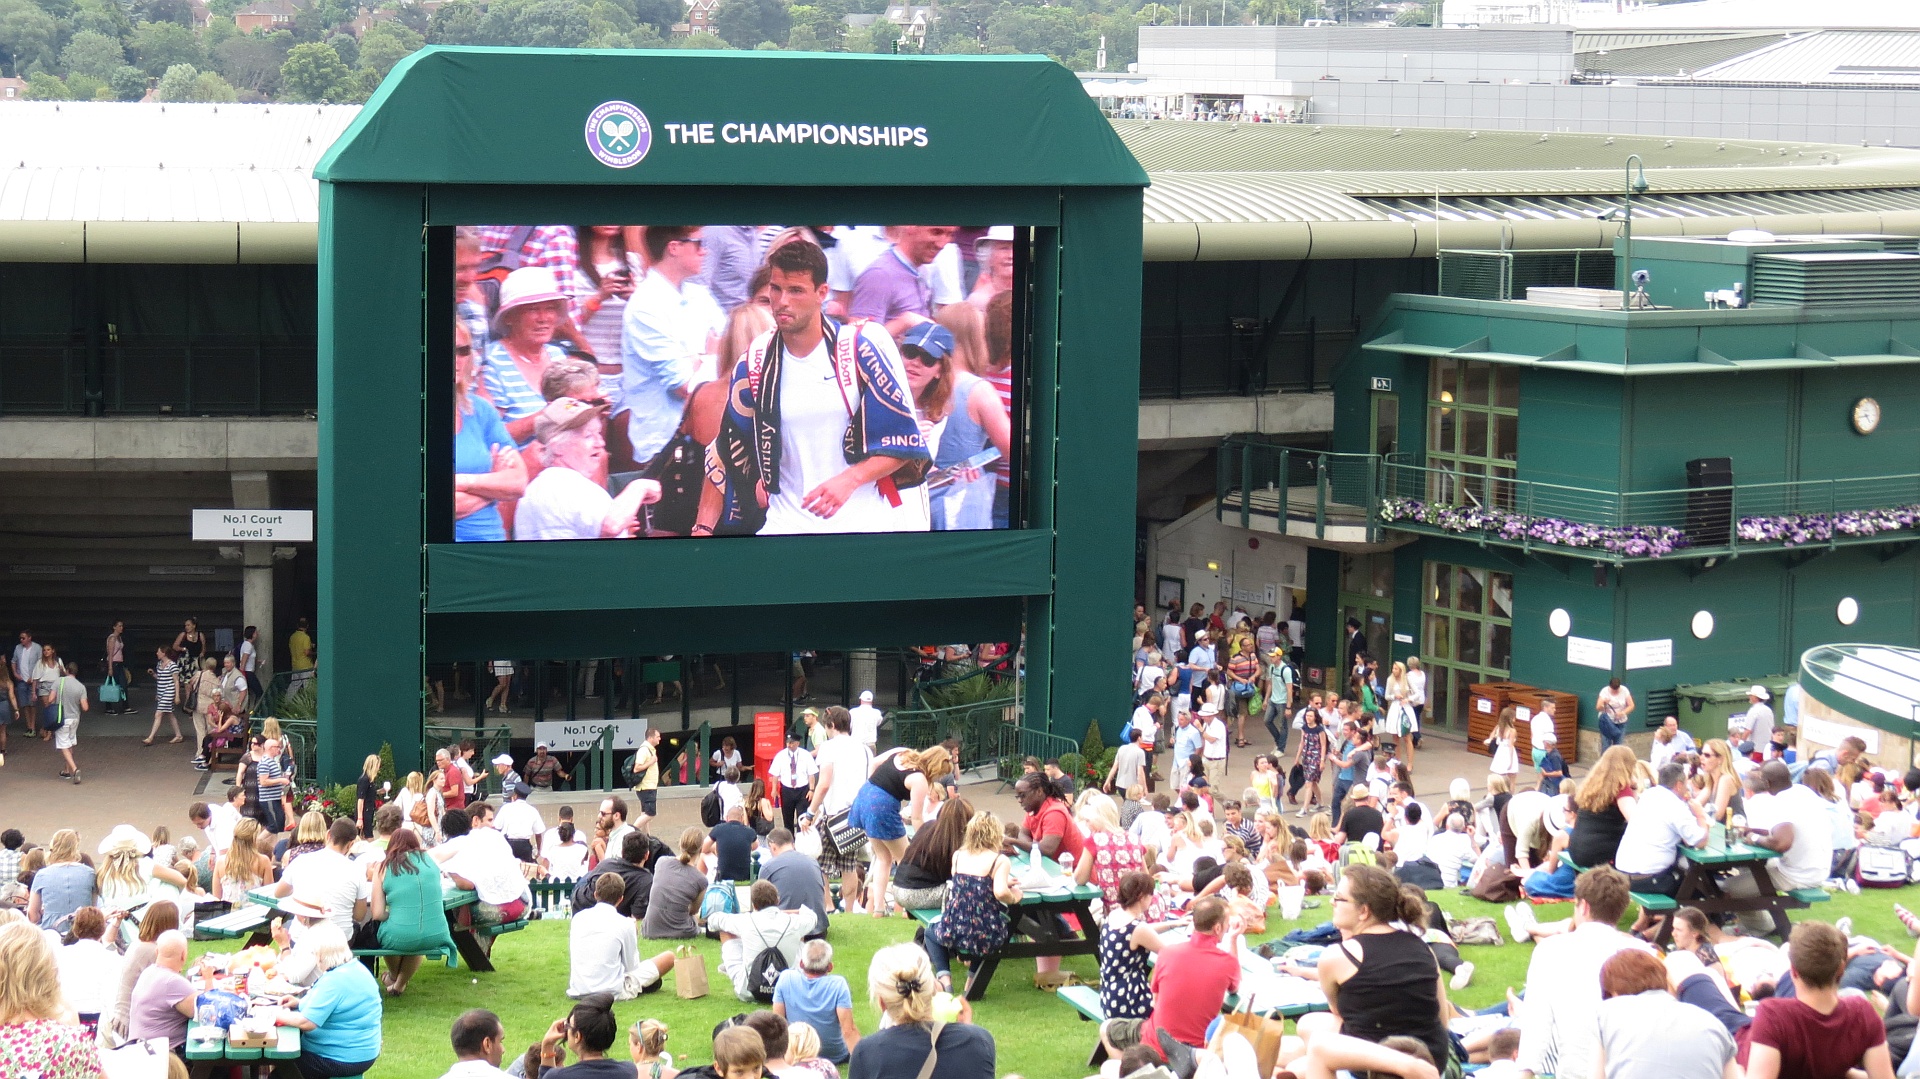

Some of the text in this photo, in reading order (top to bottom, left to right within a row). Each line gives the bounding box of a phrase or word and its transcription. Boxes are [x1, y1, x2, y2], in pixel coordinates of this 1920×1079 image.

[588, 104, 648, 133] THE CHAMPIONSHIPS
[664, 123, 929, 147] THE CHAMPIONSHIPS
[598, 149, 643, 165] WIMBLEDON
[838, 338, 853, 387] Wilson
[223, 514, 282, 524] No.1 Court
[232, 528, 273, 537] Level 3
[564, 724, 620, 735] No.1 Cot
